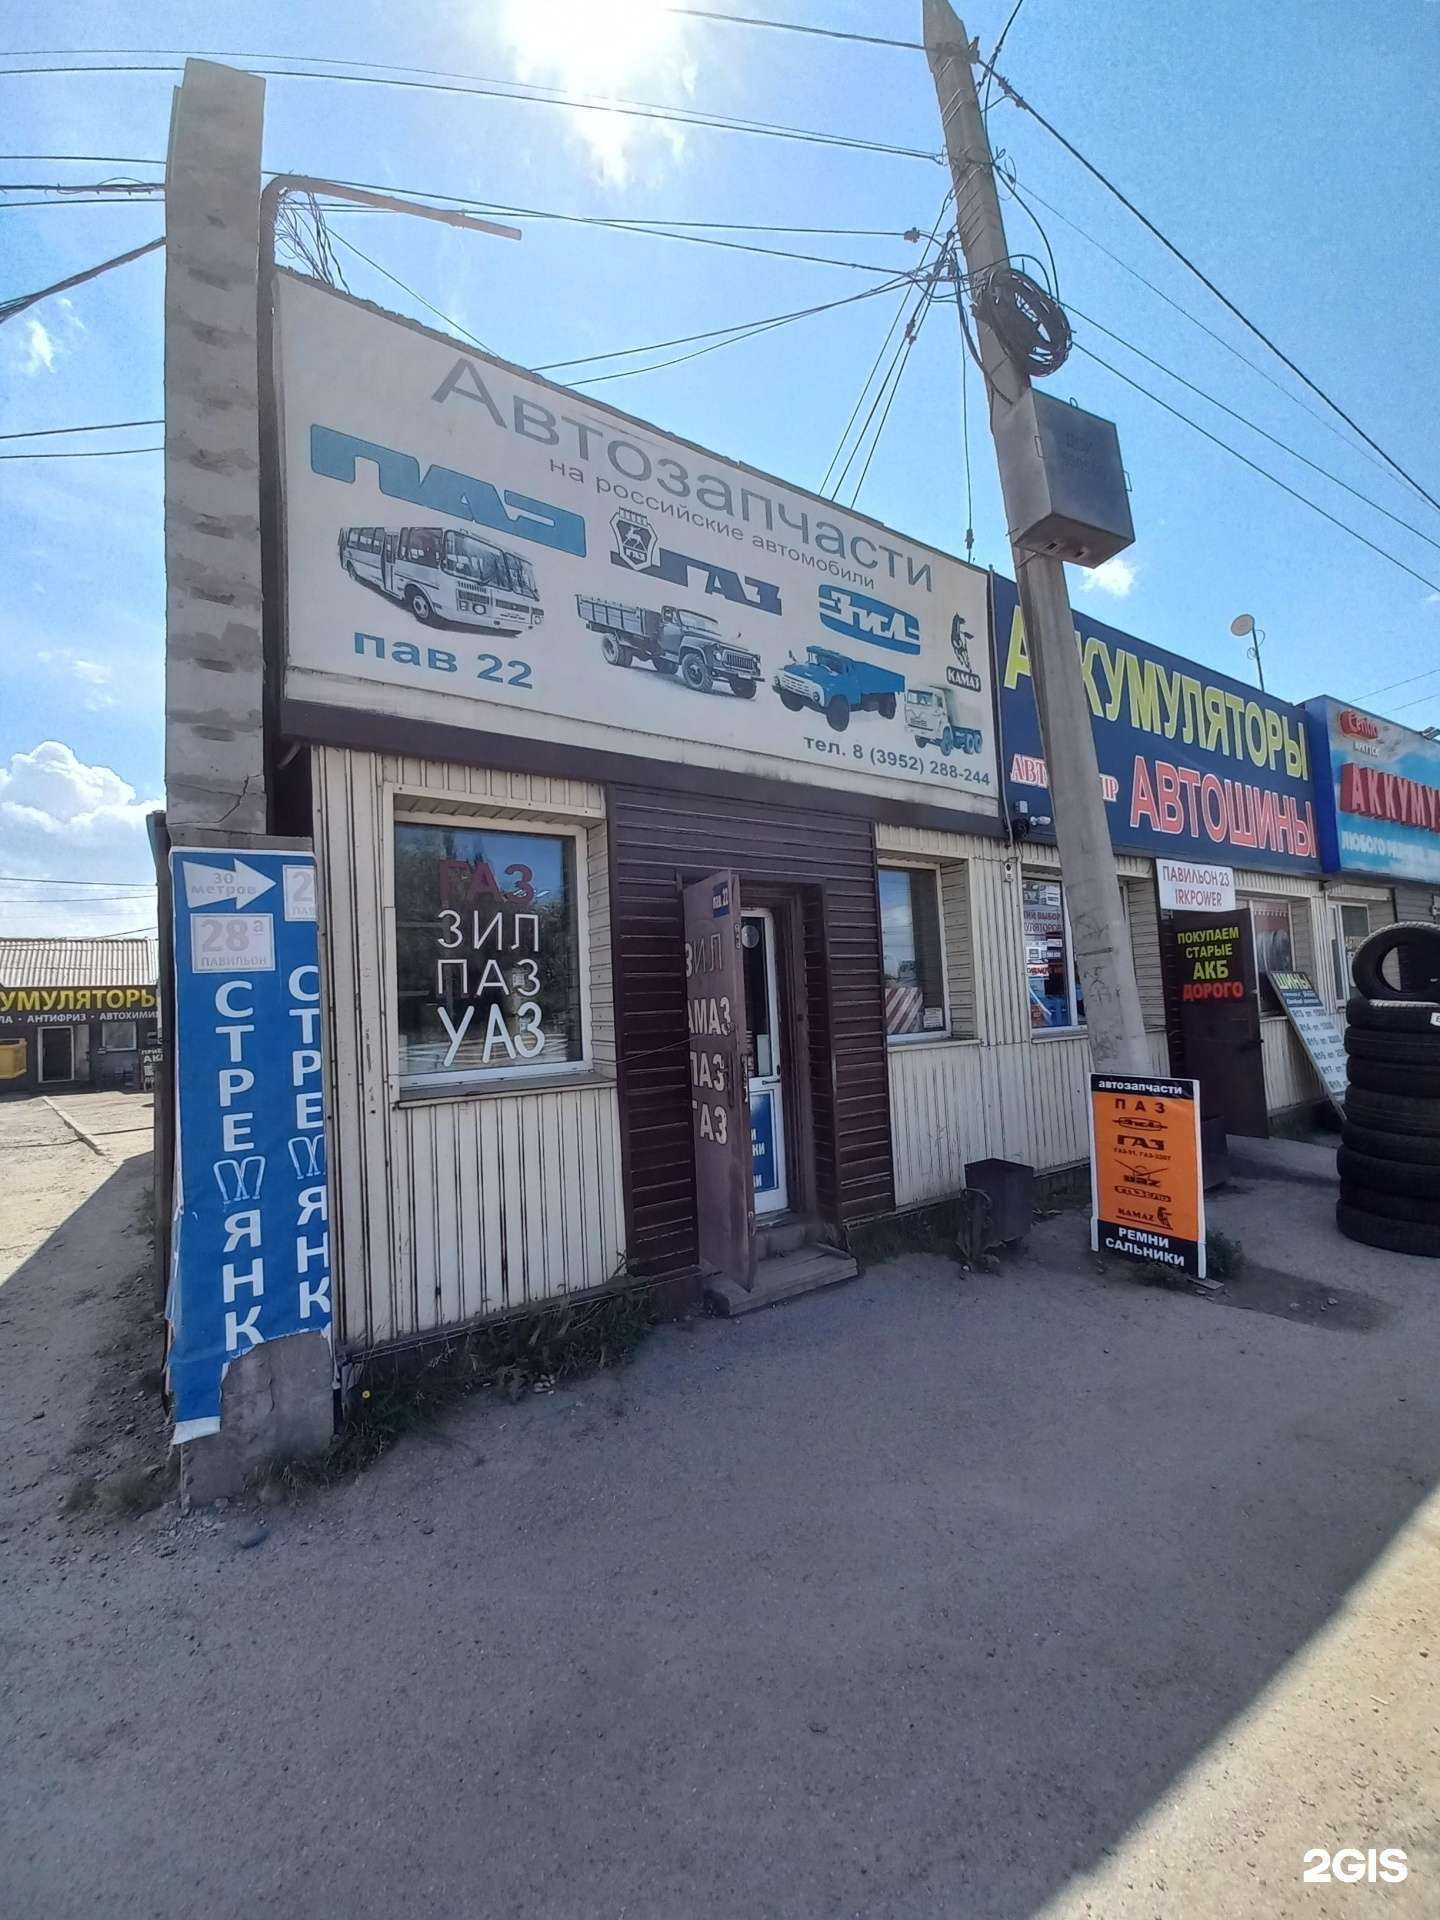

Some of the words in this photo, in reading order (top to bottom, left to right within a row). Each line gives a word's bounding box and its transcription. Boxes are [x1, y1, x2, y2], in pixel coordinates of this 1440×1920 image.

[310, 423, 587, 558] ПАЗ
[431, 358, 933, 592] Автозапчасти
[549, 459, 585, 485] на
[596, 475, 744, 541] российские
[752, 534, 876, 590] автомобили
[354, 632, 458, 673] пав
[477, 653, 534, 690] 22
[1003, 604, 1309, 781] АКУМУЛЯТОРЫ
[803, 736, 847, 757] тел.
[853, 743, 864, 760] 8
[870, 747, 924, 775] (3952)
[930, 760, 991, 786] 288-244
[1129, 754, 1317, 858] АВТОШИНЫ
[1350, 761, 1440, 831] АККУМУ
[213, 872, 234, 885] 30
[439, 859, 535, 908] ГАЗ
[1162, 865, 1218, 886] ПАВИЛЬОН
[1219, 873, 1230, 887] 23
[1175, 888, 1222, 907] IRKPOWER
[437, 909, 539, 952] ЗИЛ
[1177, 926, 1239, 945] ПОКУПАЕМ
[1186, 943, 1233, 959] СТАРЫЕ
[437, 958, 541, 998] ПАЗ
[1193, 959, 1229, 981] АКБ
[1183, 981, 1244, 1002] ДОРОГО
[27, 1013, 87, 1024] АНТИФРИЗ
[437, 1001, 546, 1067] УАЗ
[1098, 1080, 1183, 1095] автозапчасти
[692, 1099, 728, 1145] АЗ
[1117, 1134, 1165, 1151] ГАЗ
[213, 980, 266, 1352] СТРЕМЯНК
[1105, 1237, 1185, 1267] САЛЬНИКИ
[1118, 1226, 1170, 1249] РЕМНИ
